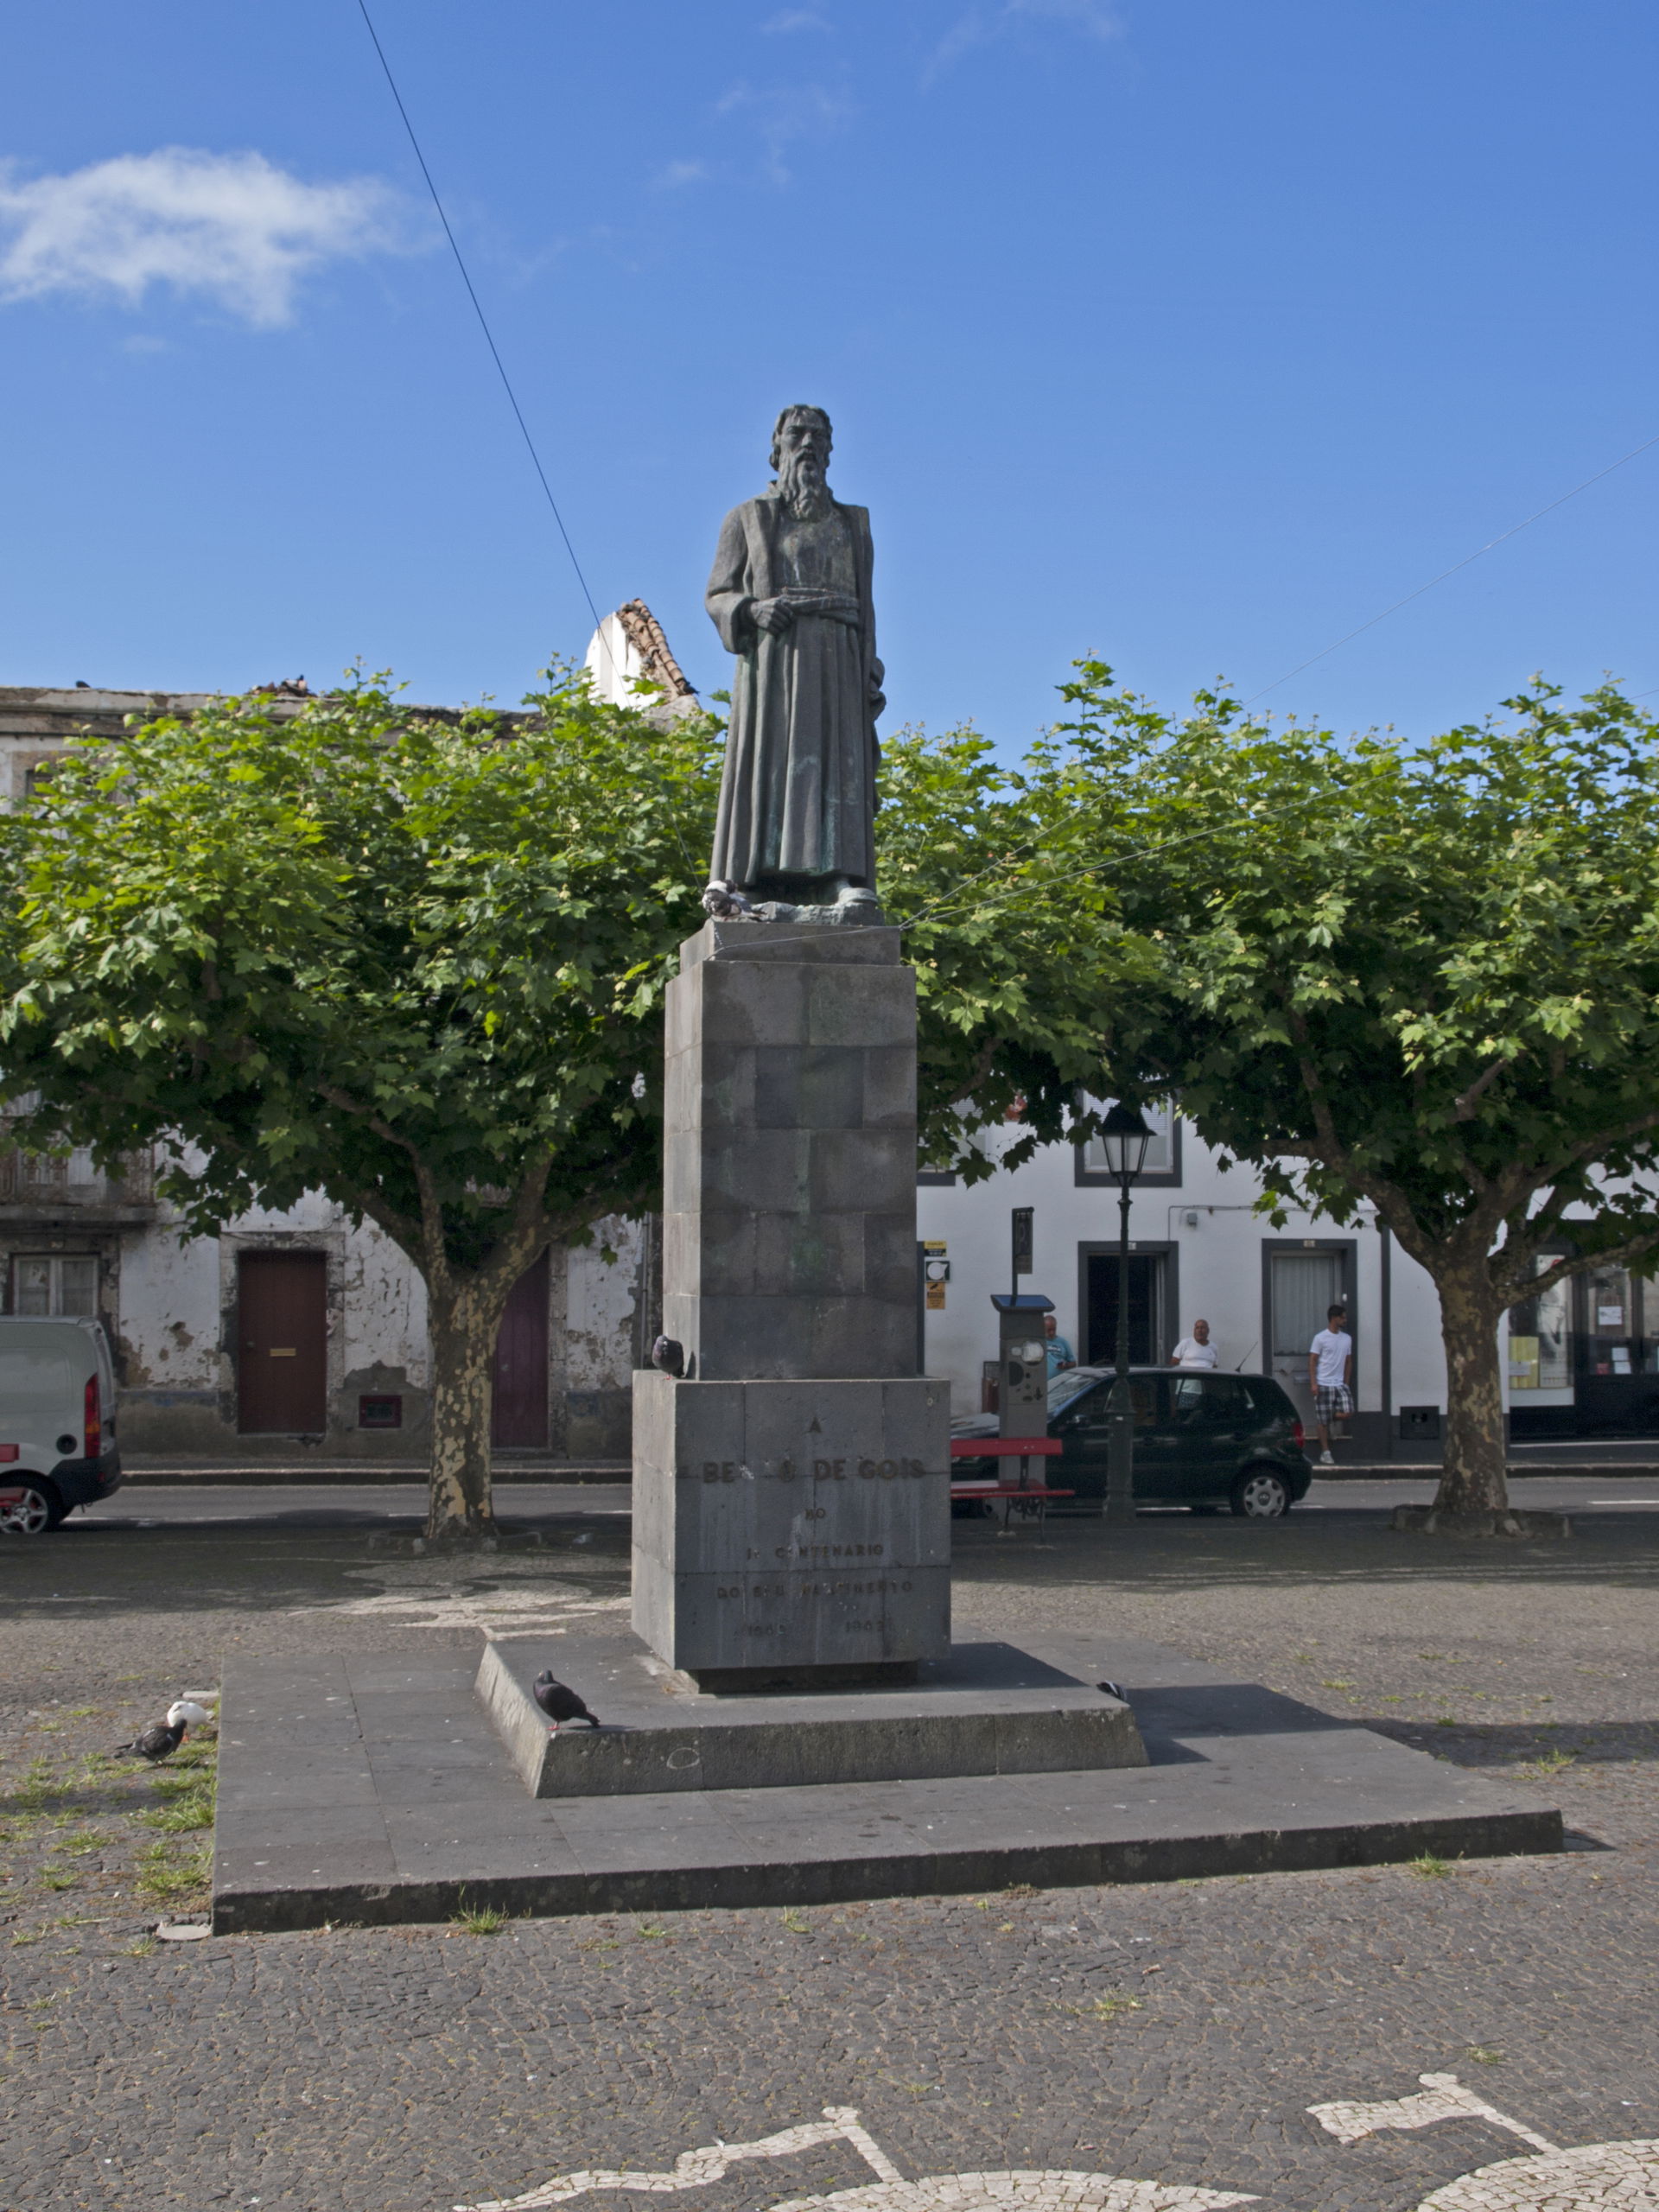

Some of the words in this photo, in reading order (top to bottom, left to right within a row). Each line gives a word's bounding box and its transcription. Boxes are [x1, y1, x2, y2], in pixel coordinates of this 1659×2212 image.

[810, 1416, 822, 1433] A
[814, 1459, 846, 1480] DE
[804, 1508, 827, 1522] NO
